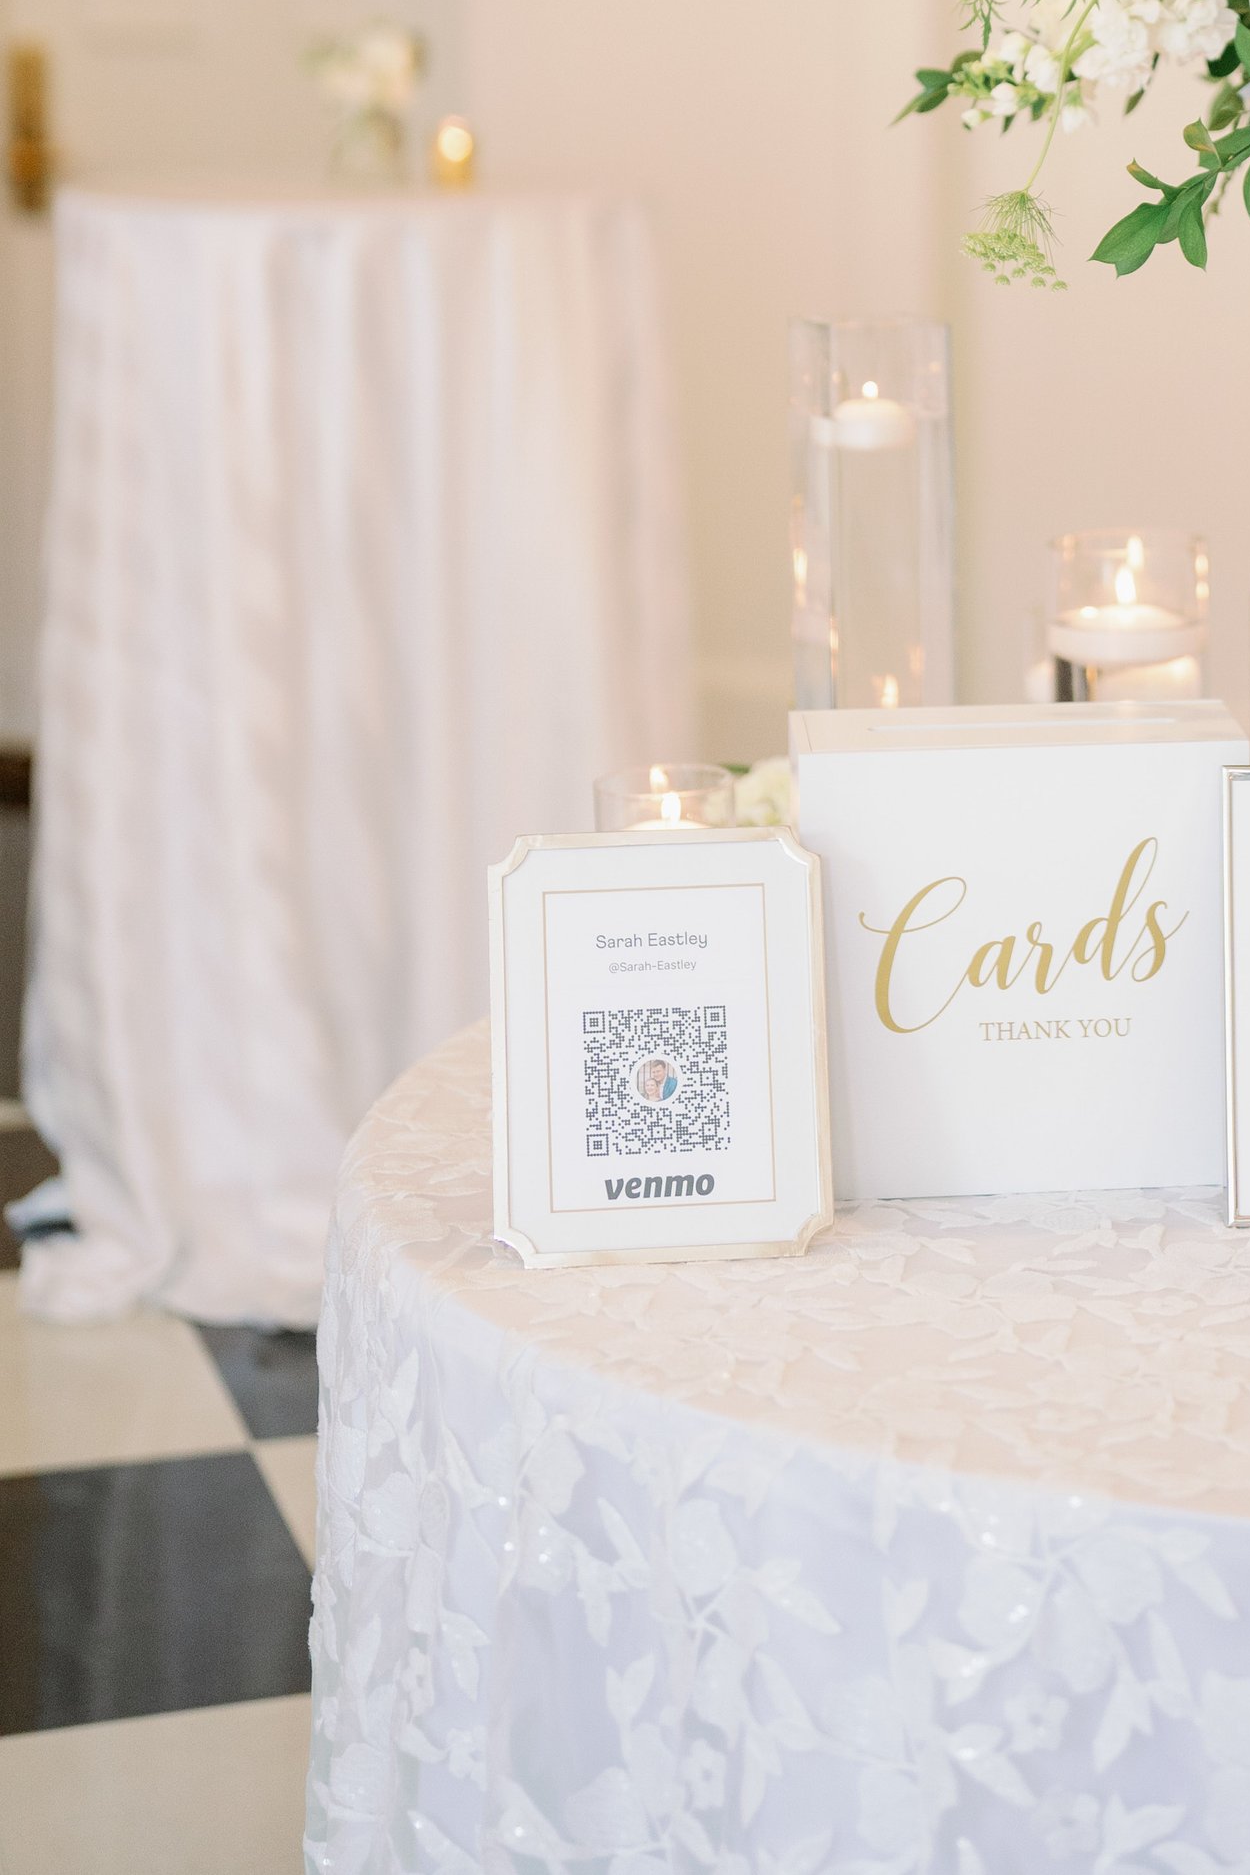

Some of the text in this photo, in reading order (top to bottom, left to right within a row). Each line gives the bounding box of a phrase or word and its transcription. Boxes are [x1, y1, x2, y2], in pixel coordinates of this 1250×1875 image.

[595, 931, 708, 949] Sarah Eastley
[858, 836, 1190, 1034] Cards
[608, 959, 697, 974] @Sarah-Eastley
[979, 1017, 1133, 1042] THANK YOU
[604, 1173, 715, 1201] venmo
